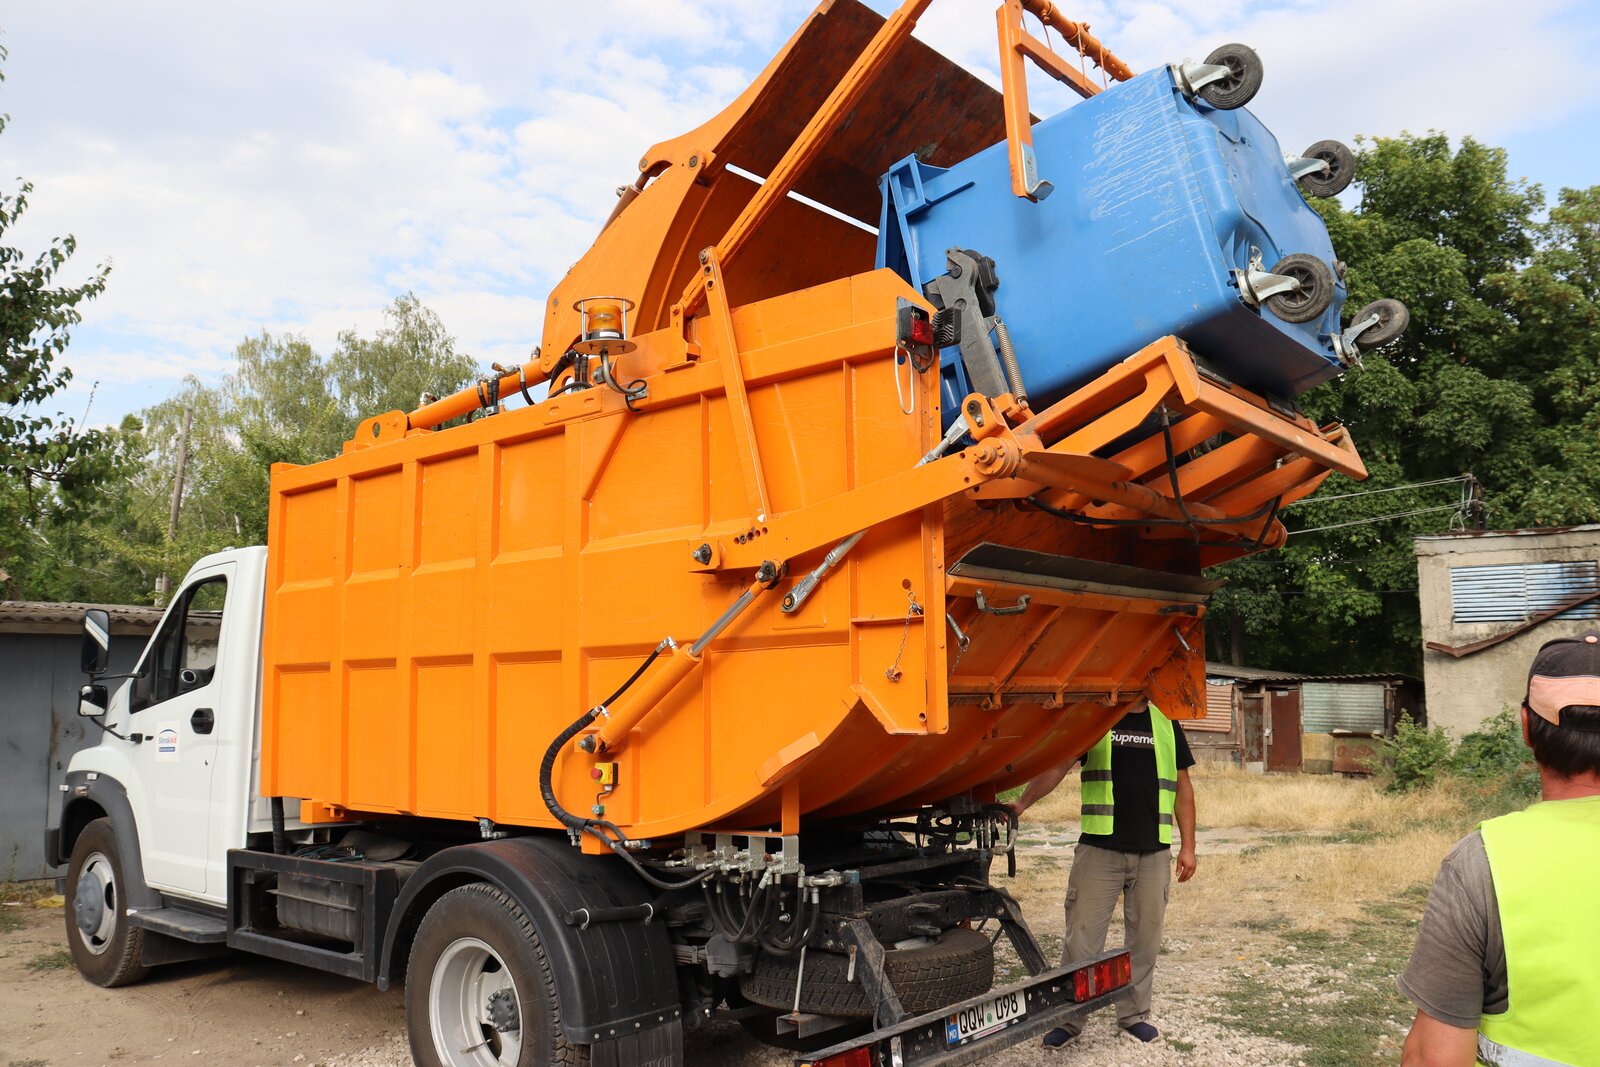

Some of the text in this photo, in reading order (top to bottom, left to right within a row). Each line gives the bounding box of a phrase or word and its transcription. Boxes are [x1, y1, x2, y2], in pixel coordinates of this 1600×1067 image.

[1110, 731, 1155, 745] Supreme
[959, 1003, 985, 1034] QQW
[995, 992, 1018, 1020] 098
[948, 1029, 957, 1040] MD
